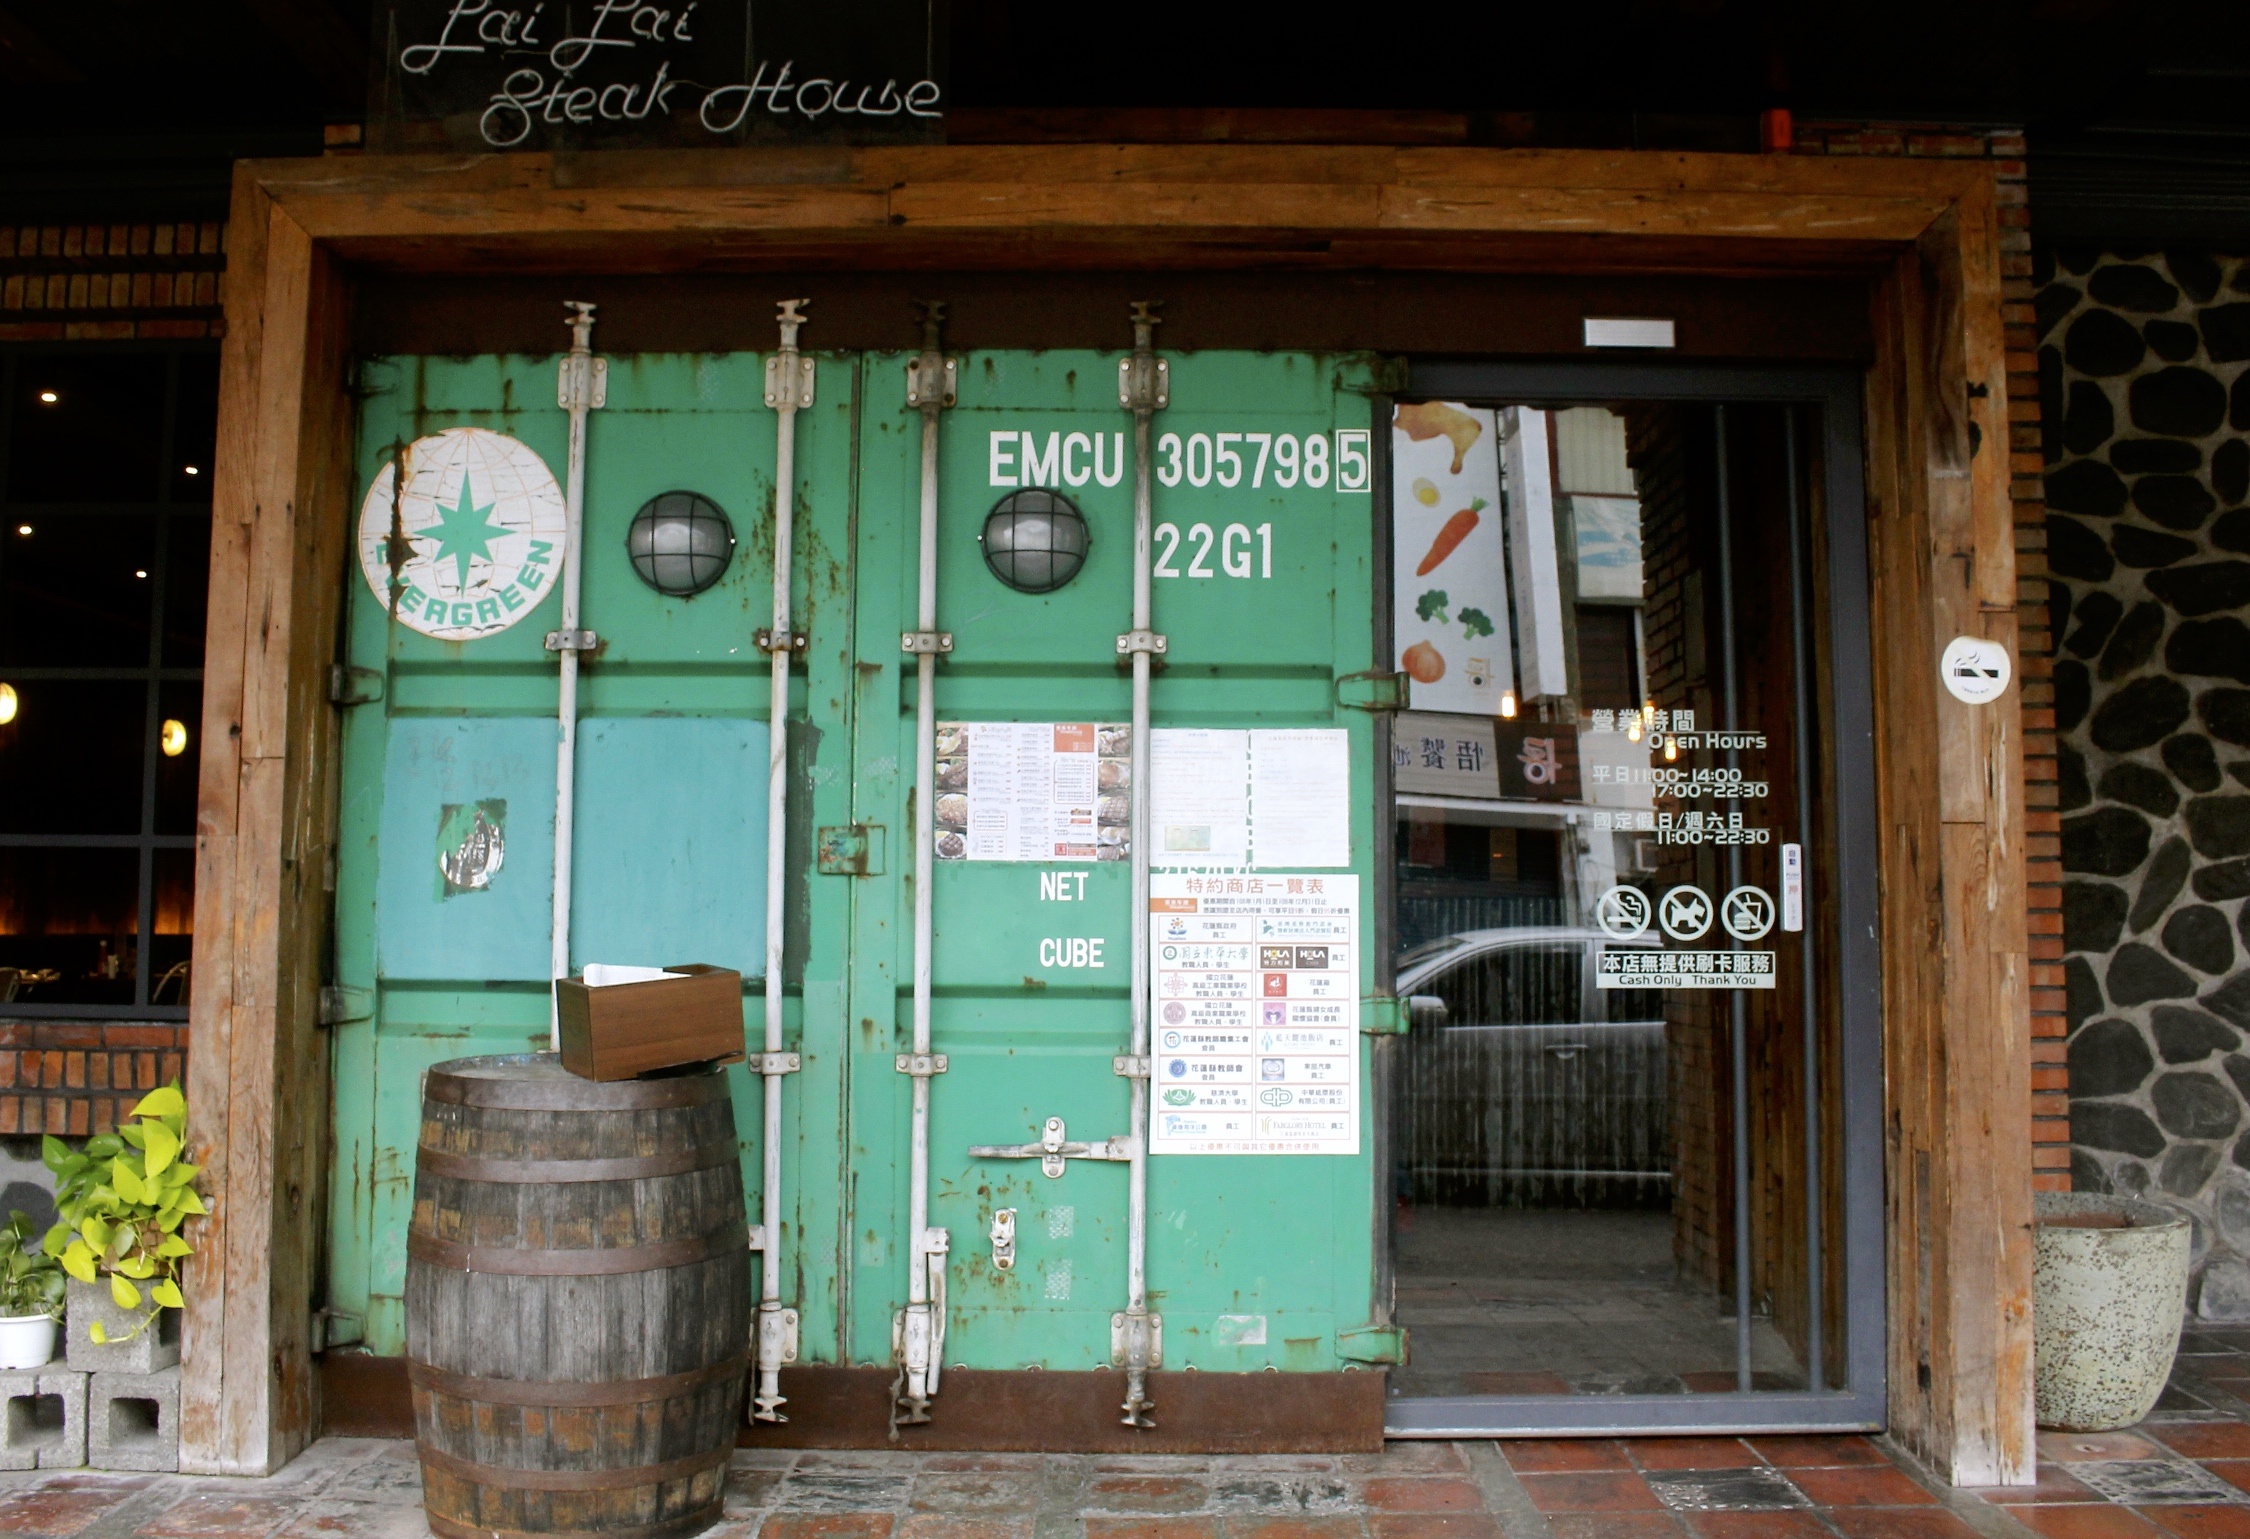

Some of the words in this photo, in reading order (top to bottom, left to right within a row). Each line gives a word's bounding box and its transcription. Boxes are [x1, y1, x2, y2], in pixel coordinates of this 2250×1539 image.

[401, 0, 540, 73] Lai
[551, 0, 695, 72] Lai
[480, 61, 676, 147] Steak
[700, 60, 944, 133] House
[988, 431, 1124, 487] EMCU
[1153, 522, 1272, 579] 22G1
[1591, 709, 1695, 732] 營業時間
[1648, 733, 1700, 750] Open
[1706, 733, 1768, 749] Hours
[1652, 783, 1769, 798] 17:00~22:30
[1658, 830, 1770, 845] 11:00~22:30
[1040, 871, 1089, 901] NET
[1186, 878, 1324, 894] 特約商店一覽表
[1039, 937, 1105, 968] CUBE
[1178, 946, 1249, 961] 國立東華大學
[1263, 949, 1290, 960] HOLA
[1300, 949, 1326, 960] HOLA
[1603, 954, 1770, 974] 本店無提供刷卡服務
[1618, 974, 1651, 985] Cash
[1653, 974, 1682, 987] Only
[1692, 974, 1731, 985] Thank
[1734, 974, 1757, 985] You
